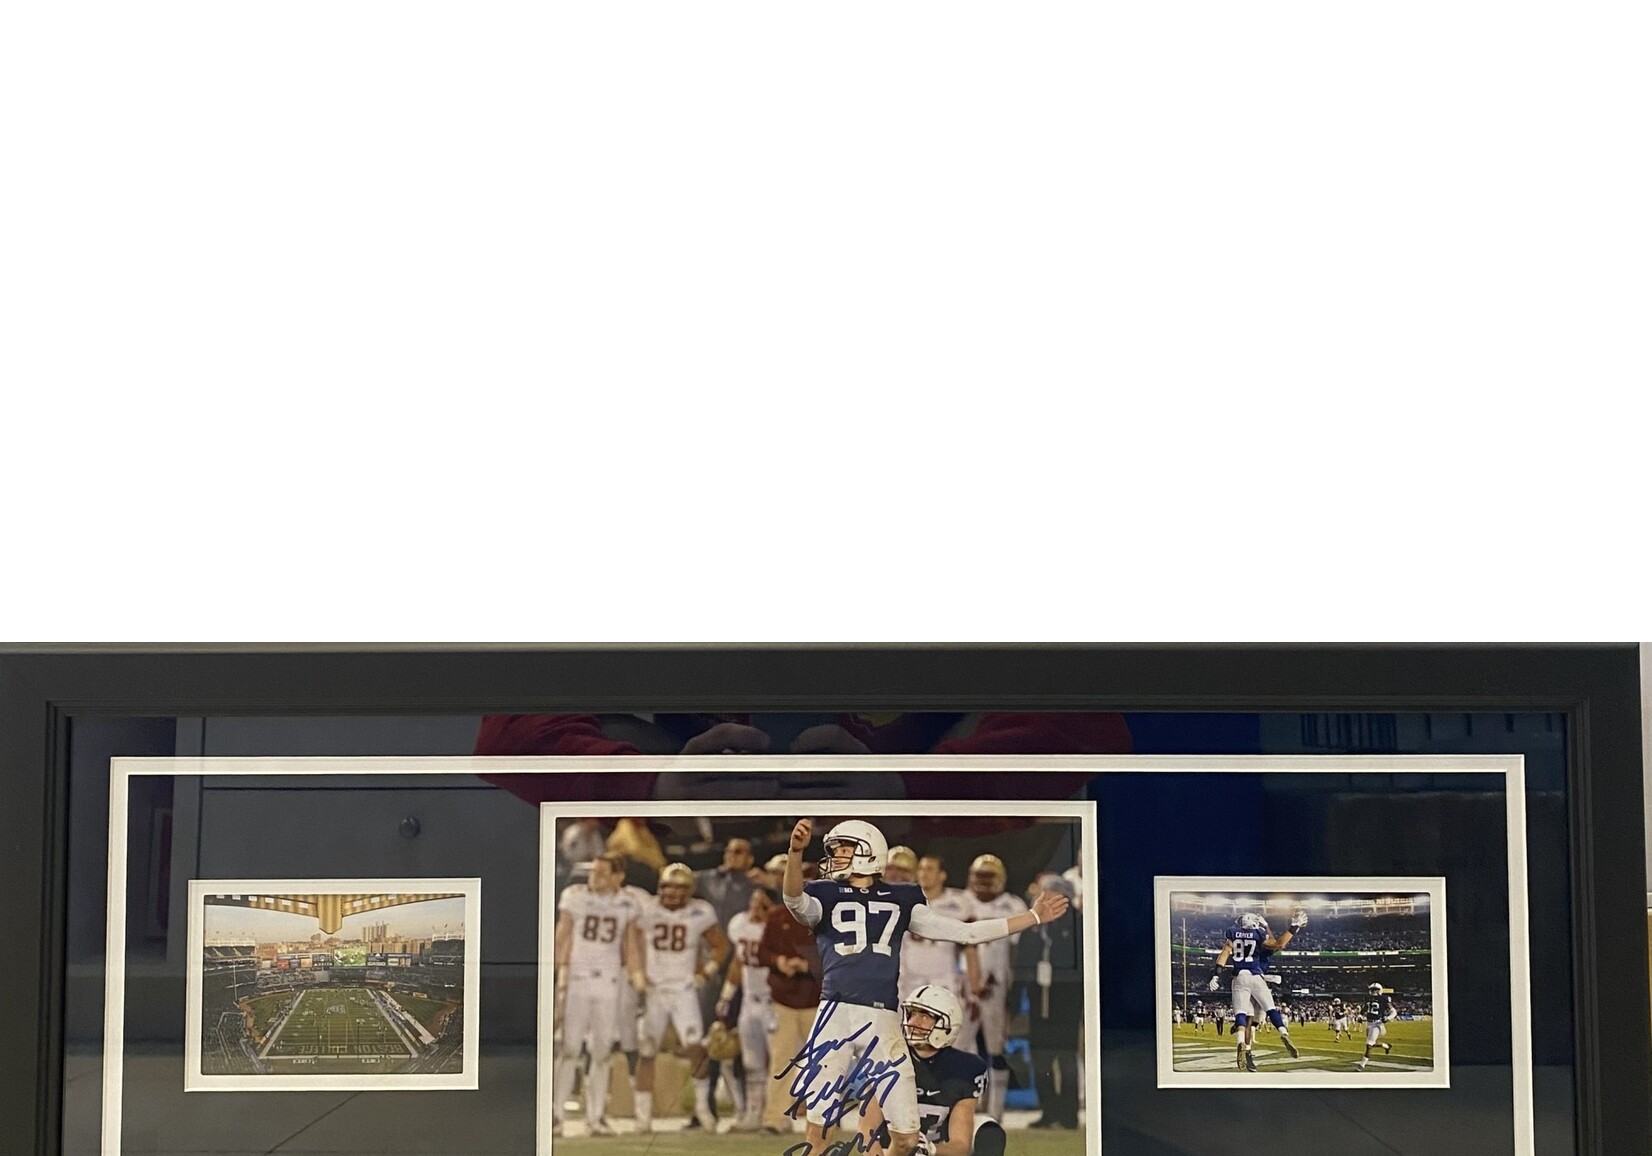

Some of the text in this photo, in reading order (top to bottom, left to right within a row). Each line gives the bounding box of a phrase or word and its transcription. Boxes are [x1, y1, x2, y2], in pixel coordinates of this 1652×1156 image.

[583, 914, 618, 943] 83
[653, 923, 687, 952] 28
[831, 901, 901, 957] 97
[1232, 939, 1257, 963] 87
[1366, 1001, 1380, 1015] 12
